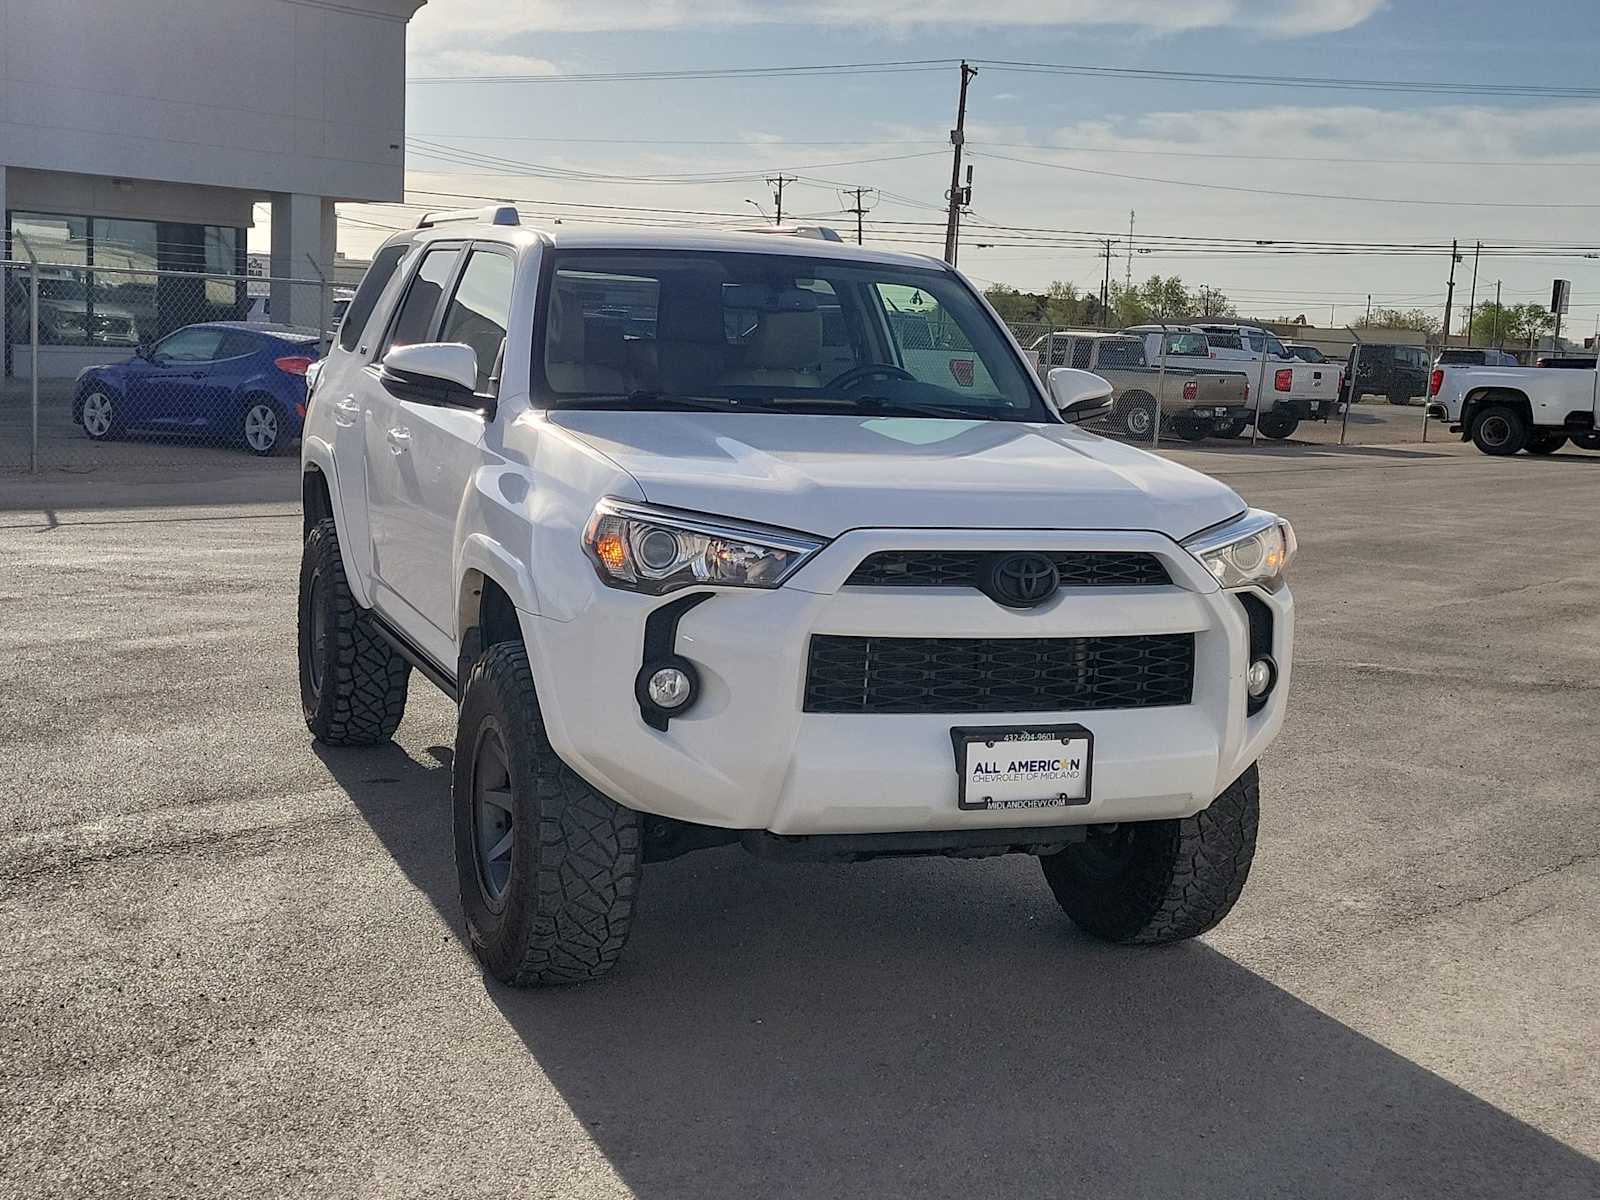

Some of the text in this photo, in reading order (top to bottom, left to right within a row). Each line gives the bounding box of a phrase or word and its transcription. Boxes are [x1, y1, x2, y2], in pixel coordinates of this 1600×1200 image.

[973, 762, 1000, 774] ALL
[972, 771, 1080, 783] CHEVROLET OF MIDLAND
[987, 799, 1066, 810] MIDLANDCHEVY.COM
